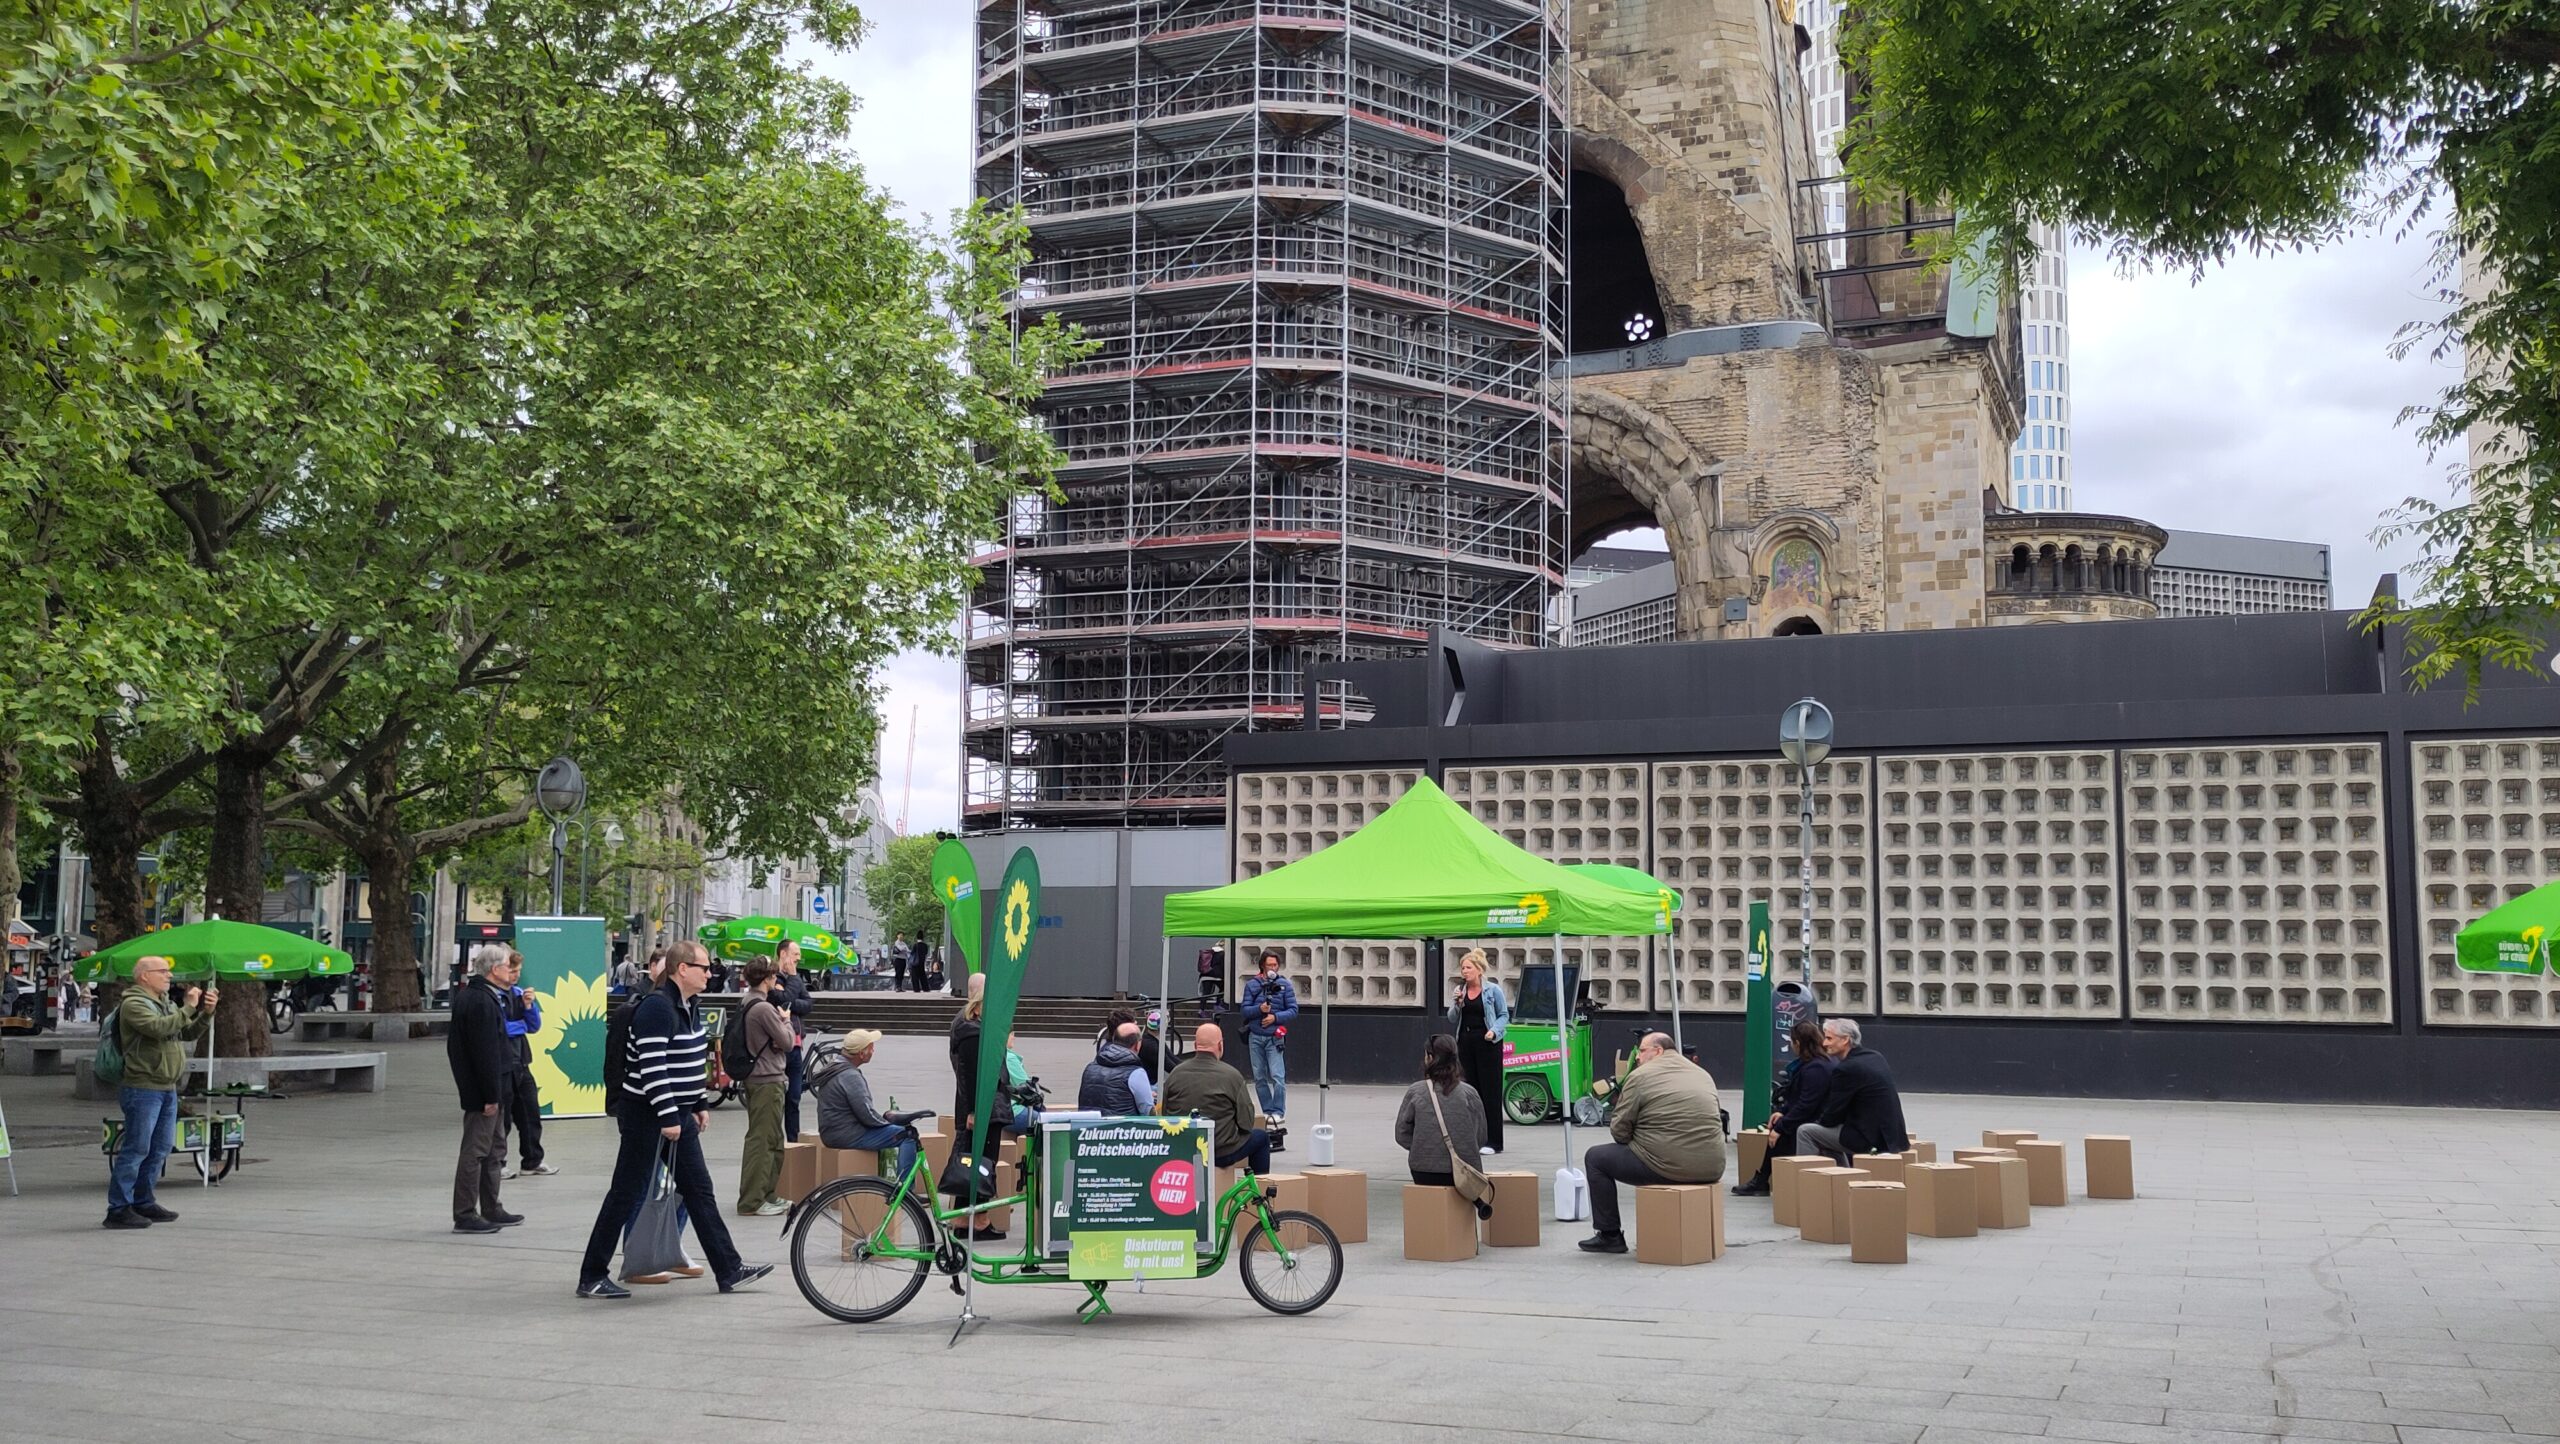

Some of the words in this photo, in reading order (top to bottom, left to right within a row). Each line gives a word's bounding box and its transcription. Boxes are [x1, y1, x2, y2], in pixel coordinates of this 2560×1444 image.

[1078, 1127, 1163, 1140] Zukunftsforum
[1078, 1143, 1170, 1158] Breitscheidplatz
[1158, 1171, 1189, 1186] JETZT
[1159, 1189, 1187, 1204] HIER!
[1125, 1238, 1184, 1251] Diskutieren
[1124, 1255, 1139, 1268] Sie
[1142, 1254, 1160, 1267] mit
[1162, 1254, 1184, 1267] uns!
